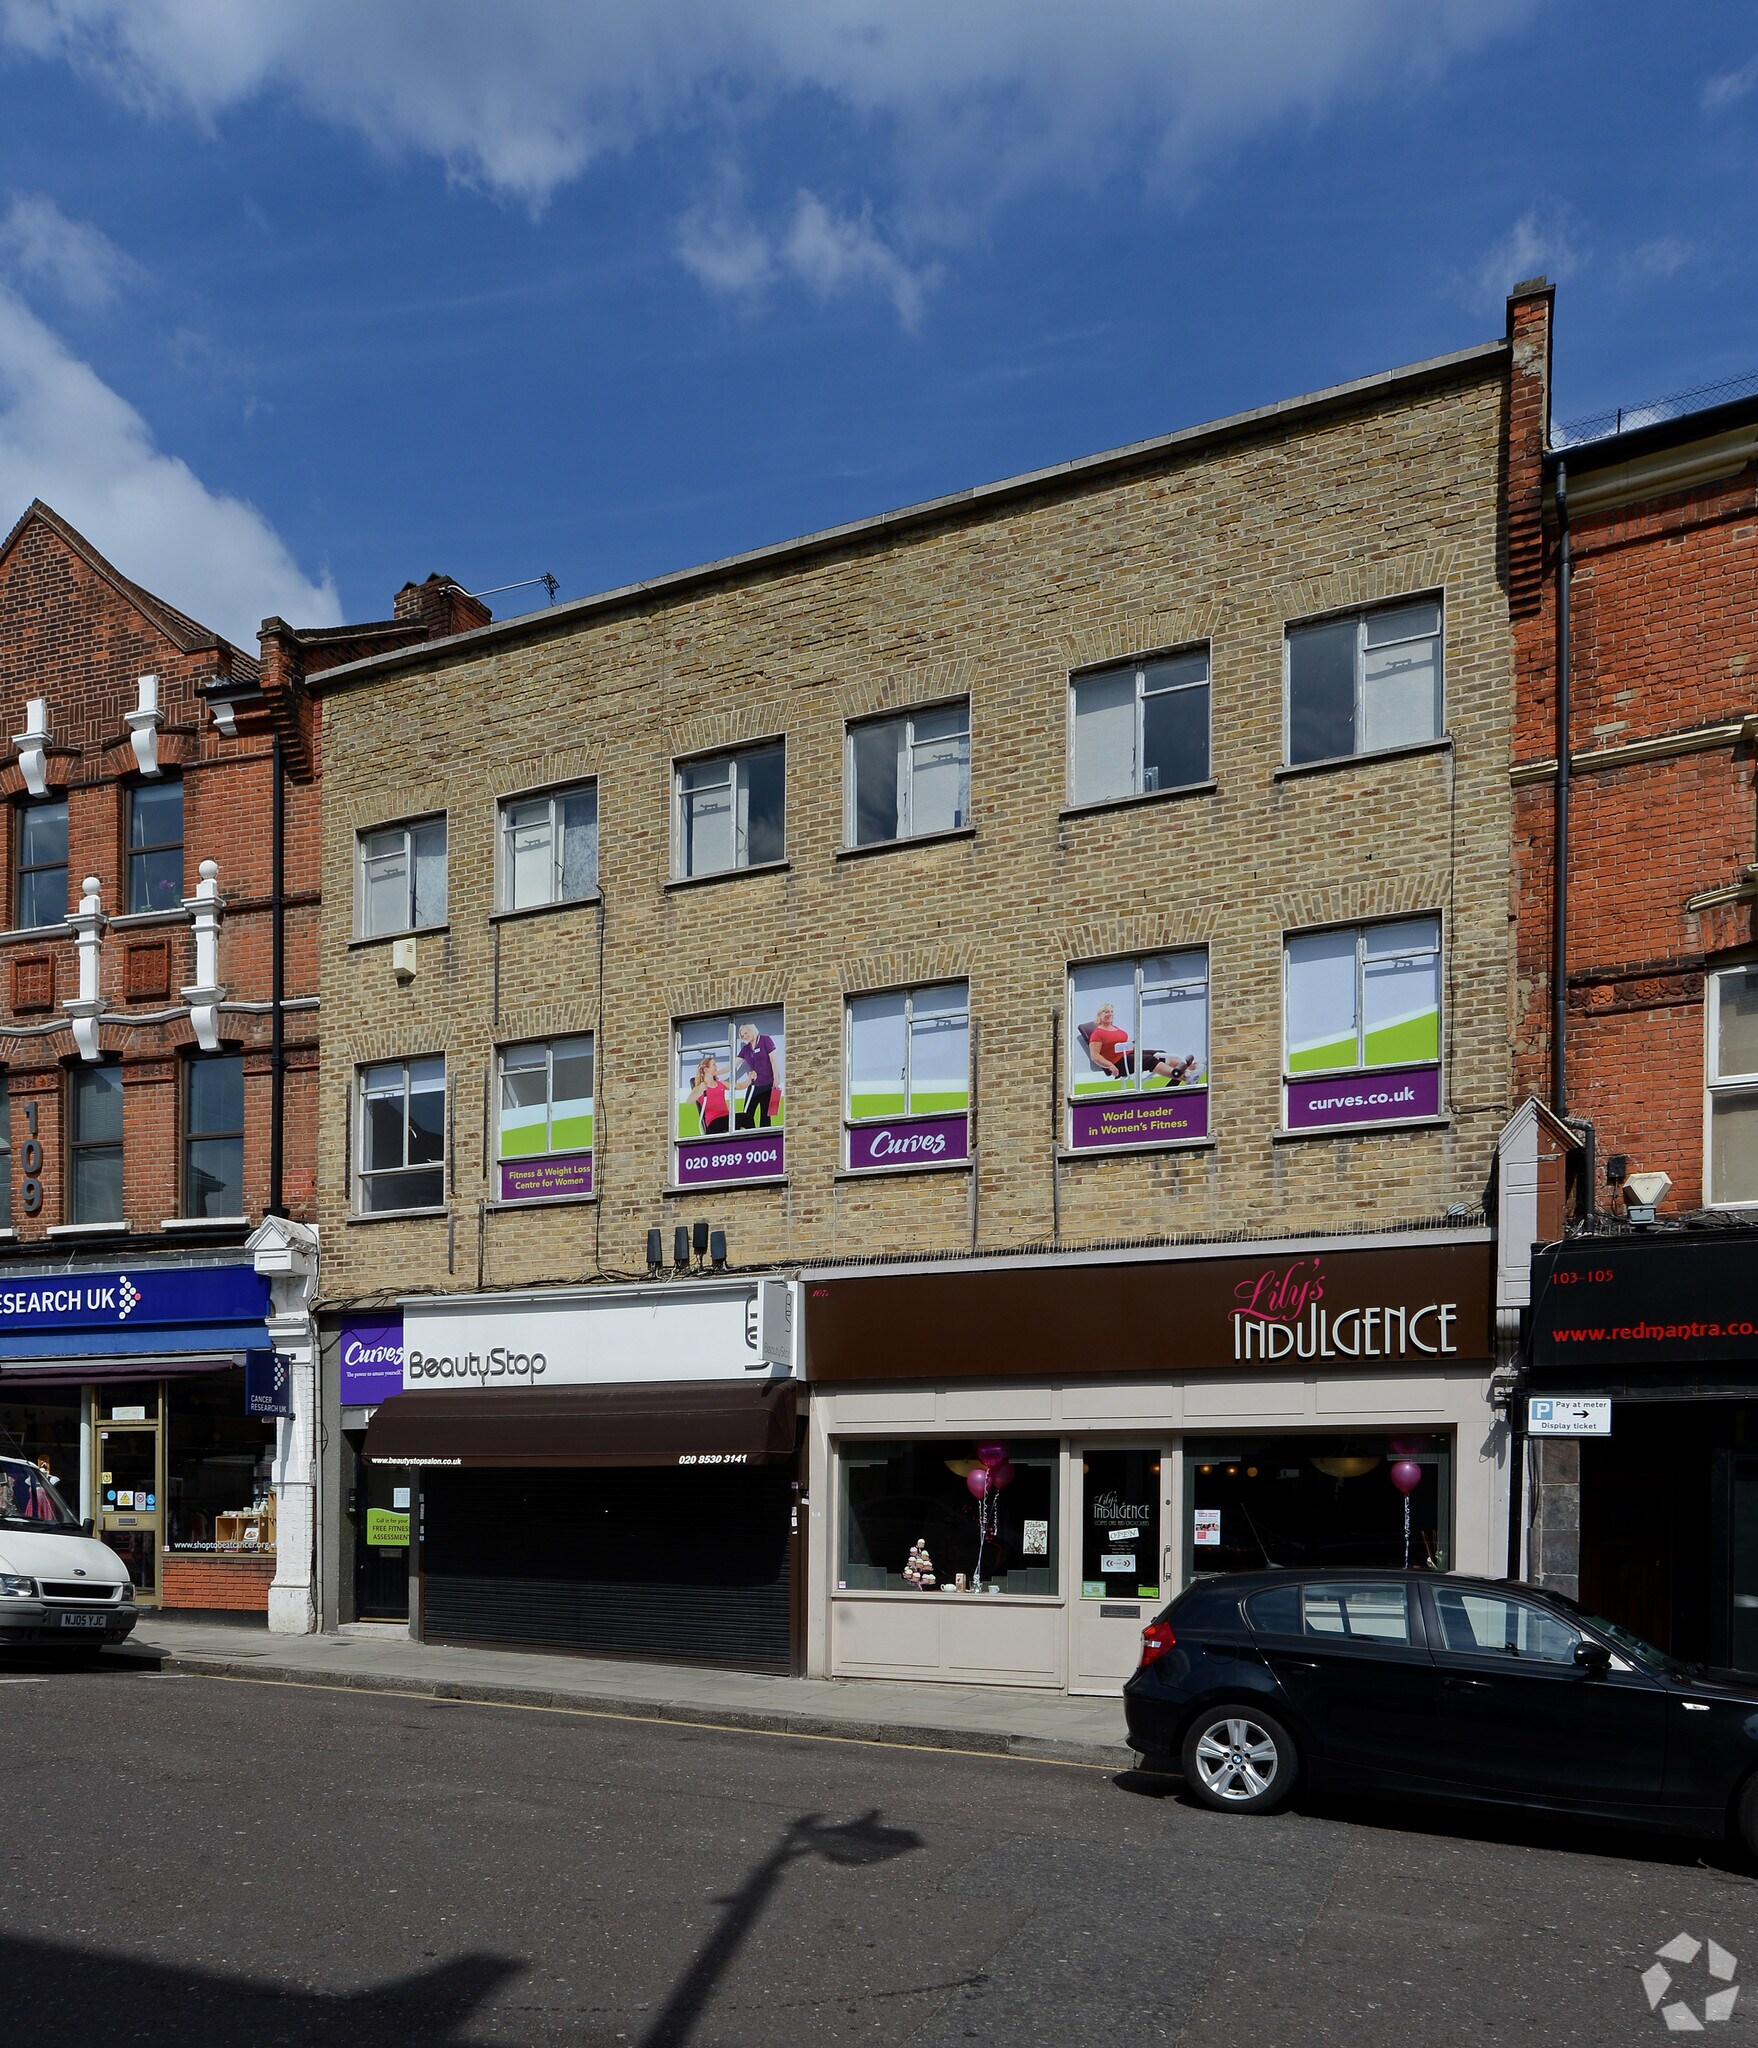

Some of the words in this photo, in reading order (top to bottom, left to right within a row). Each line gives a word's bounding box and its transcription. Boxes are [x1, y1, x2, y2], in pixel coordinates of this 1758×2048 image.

[1308, 1086, 1415, 1110] curves.co.uk
[1103, 1109, 1134, 1121] World
[1137, 1107, 1173, 1119] Leader
[1088, 1127, 1098, 1136] in
[1101, 1122, 1148, 1134] Women's
[1150, 1119, 1188, 1130] Fitness
[869, 1130, 946, 1158] Curves
[21, 1101, 43, 1212] 109
[685, 1157, 709, 1170] 020
[711, 1153, 742, 1167] 8989
[745, 1149, 777, 1163] 9004
[509, 1171, 535, 1179] Fitness
[536, 1169, 543, 1177] &
[544, 1166, 572, 1177] Weight
[573, 1165, 591, 1173] Loss
[515, 1181, 541, 1190] Centre
[542, 1179, 554, 1187] for
[555, 1177, 584, 1186] Women
[1552, 1269, 1614, 1285] 103-105
[1228, 1257, 1326, 1322] Lily's
[0, 1288, 82, 1314] SEARCH
[87, 1287, 116, 1310] UK
[1234, 1302, 1457, 1360] INDULGENCE
[344, 1341, 404, 1366] Curves
[409, 1347, 547, 1386] BeautyStop
[250, 1395, 273, 1404] CANCER
[250, 1403, 279, 1412] RESEARCH
[279, 1405, 288, 1413] UK
[1541, 1422, 1571, 1430] Display
[371, 1457, 462, 1466] www.beautystopsalon.co.uk
[679, 1455, 697, 1465] 020
[698, 1454, 723, 1464] 8530
[723, 1454, 748, 1463] 3141
[1110, 1529, 1138, 1540] OPEN
[88, 1615, 104, 1627] YJC
